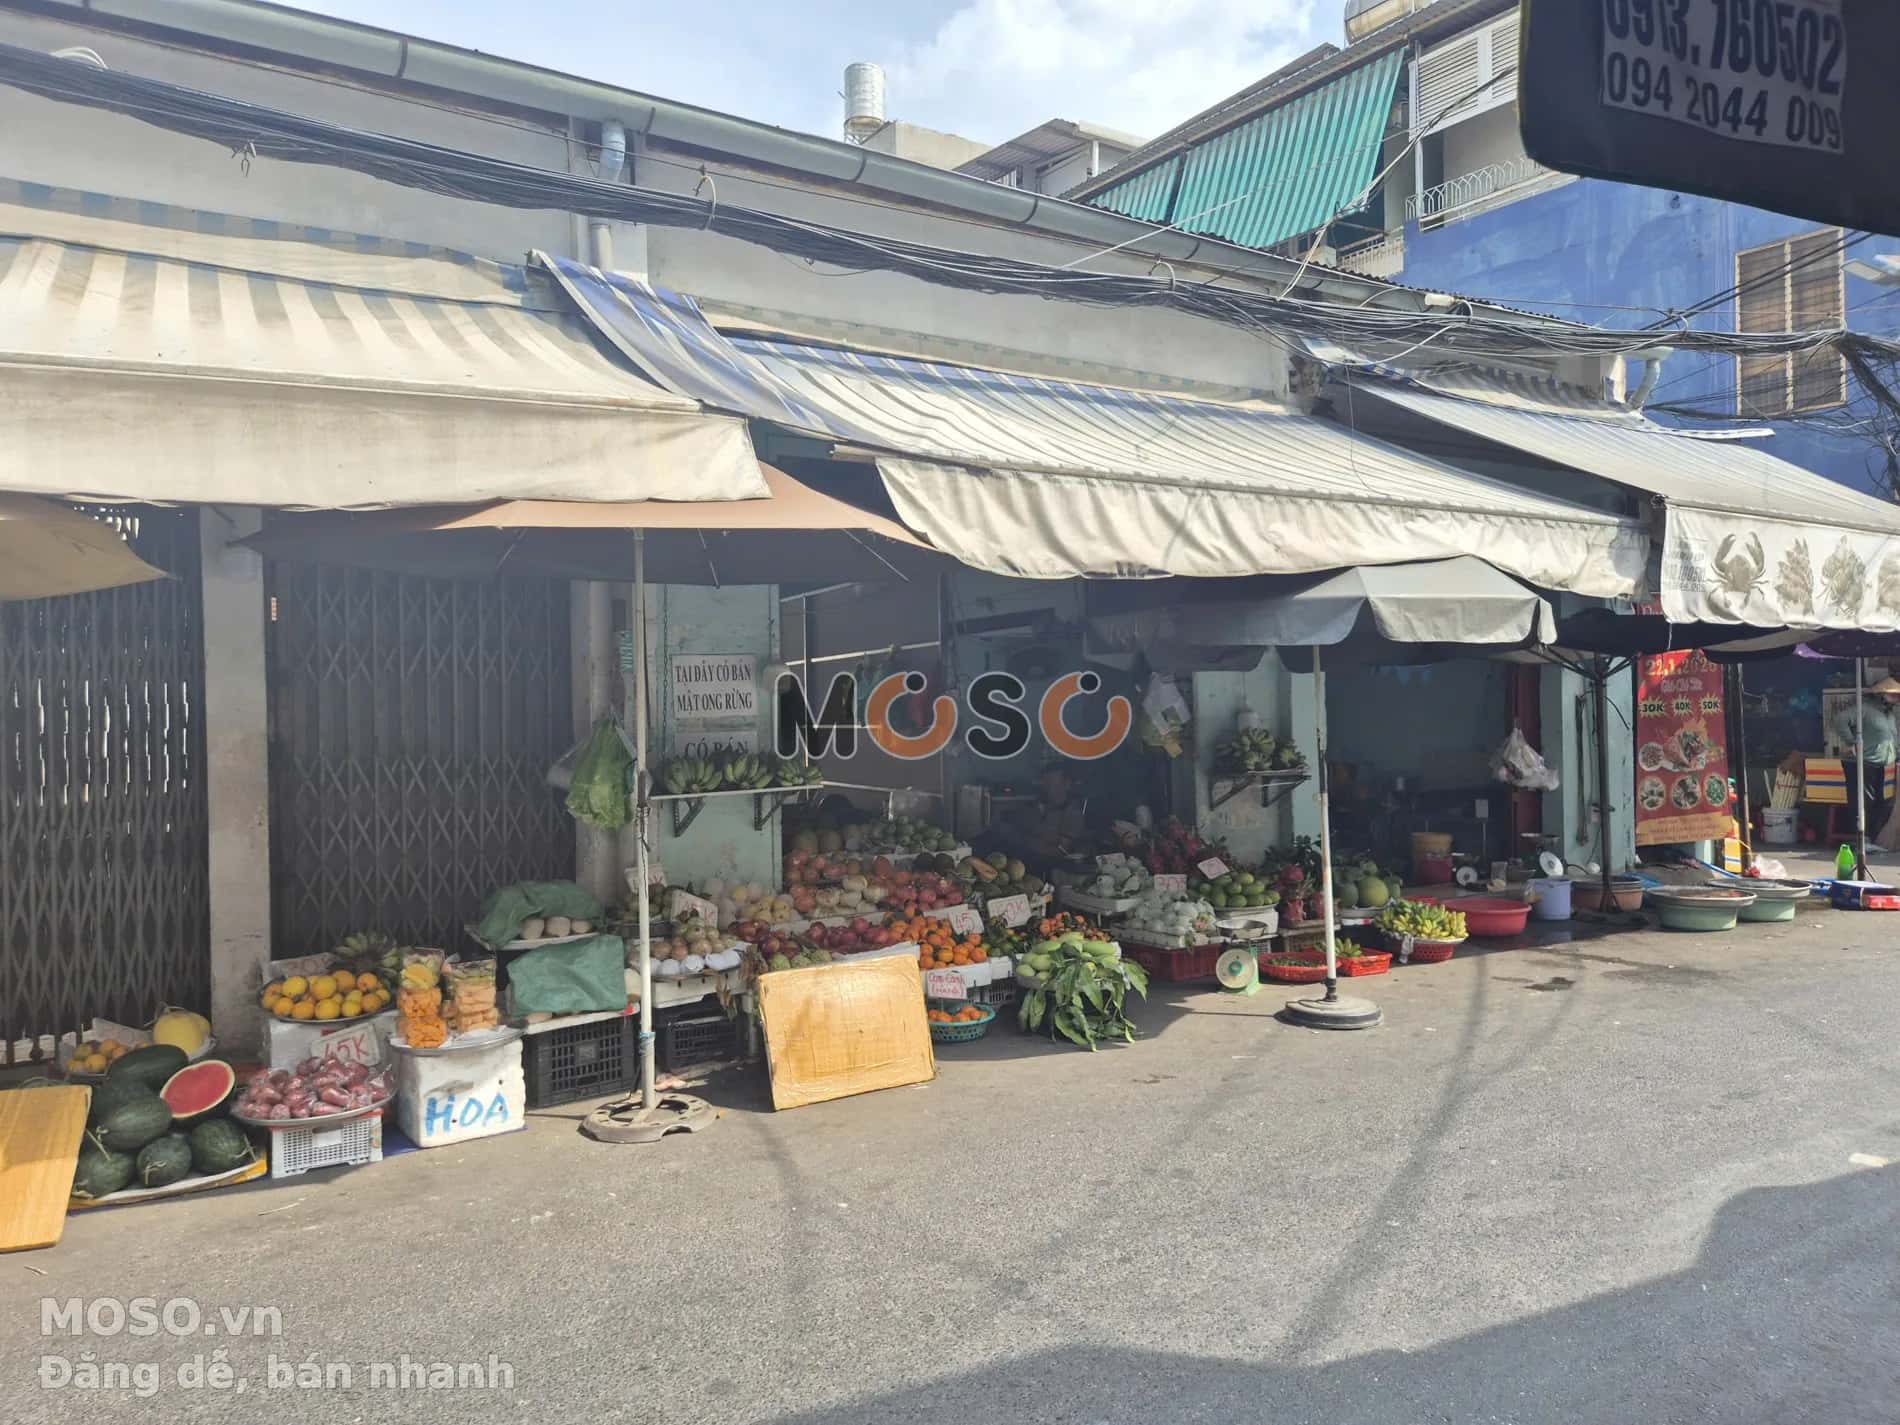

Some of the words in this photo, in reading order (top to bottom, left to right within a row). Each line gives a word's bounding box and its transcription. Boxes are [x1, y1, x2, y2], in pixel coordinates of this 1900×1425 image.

[1607, 52, 1672, 112] 094
[1686, 75, 1768, 136] 2044
[1786, 96, 1841, 149] 009
[675, 665, 692, 686] TẠI
[694, 660, 714, 682] ĐÂY
[716, 660, 730, 681] CÓ
[731, 659, 751, 680] BÁN
[677, 689, 700, 715] MẬT
[702, 693, 722, 711] ONG
[725, 688, 752, 710] RỪNG
